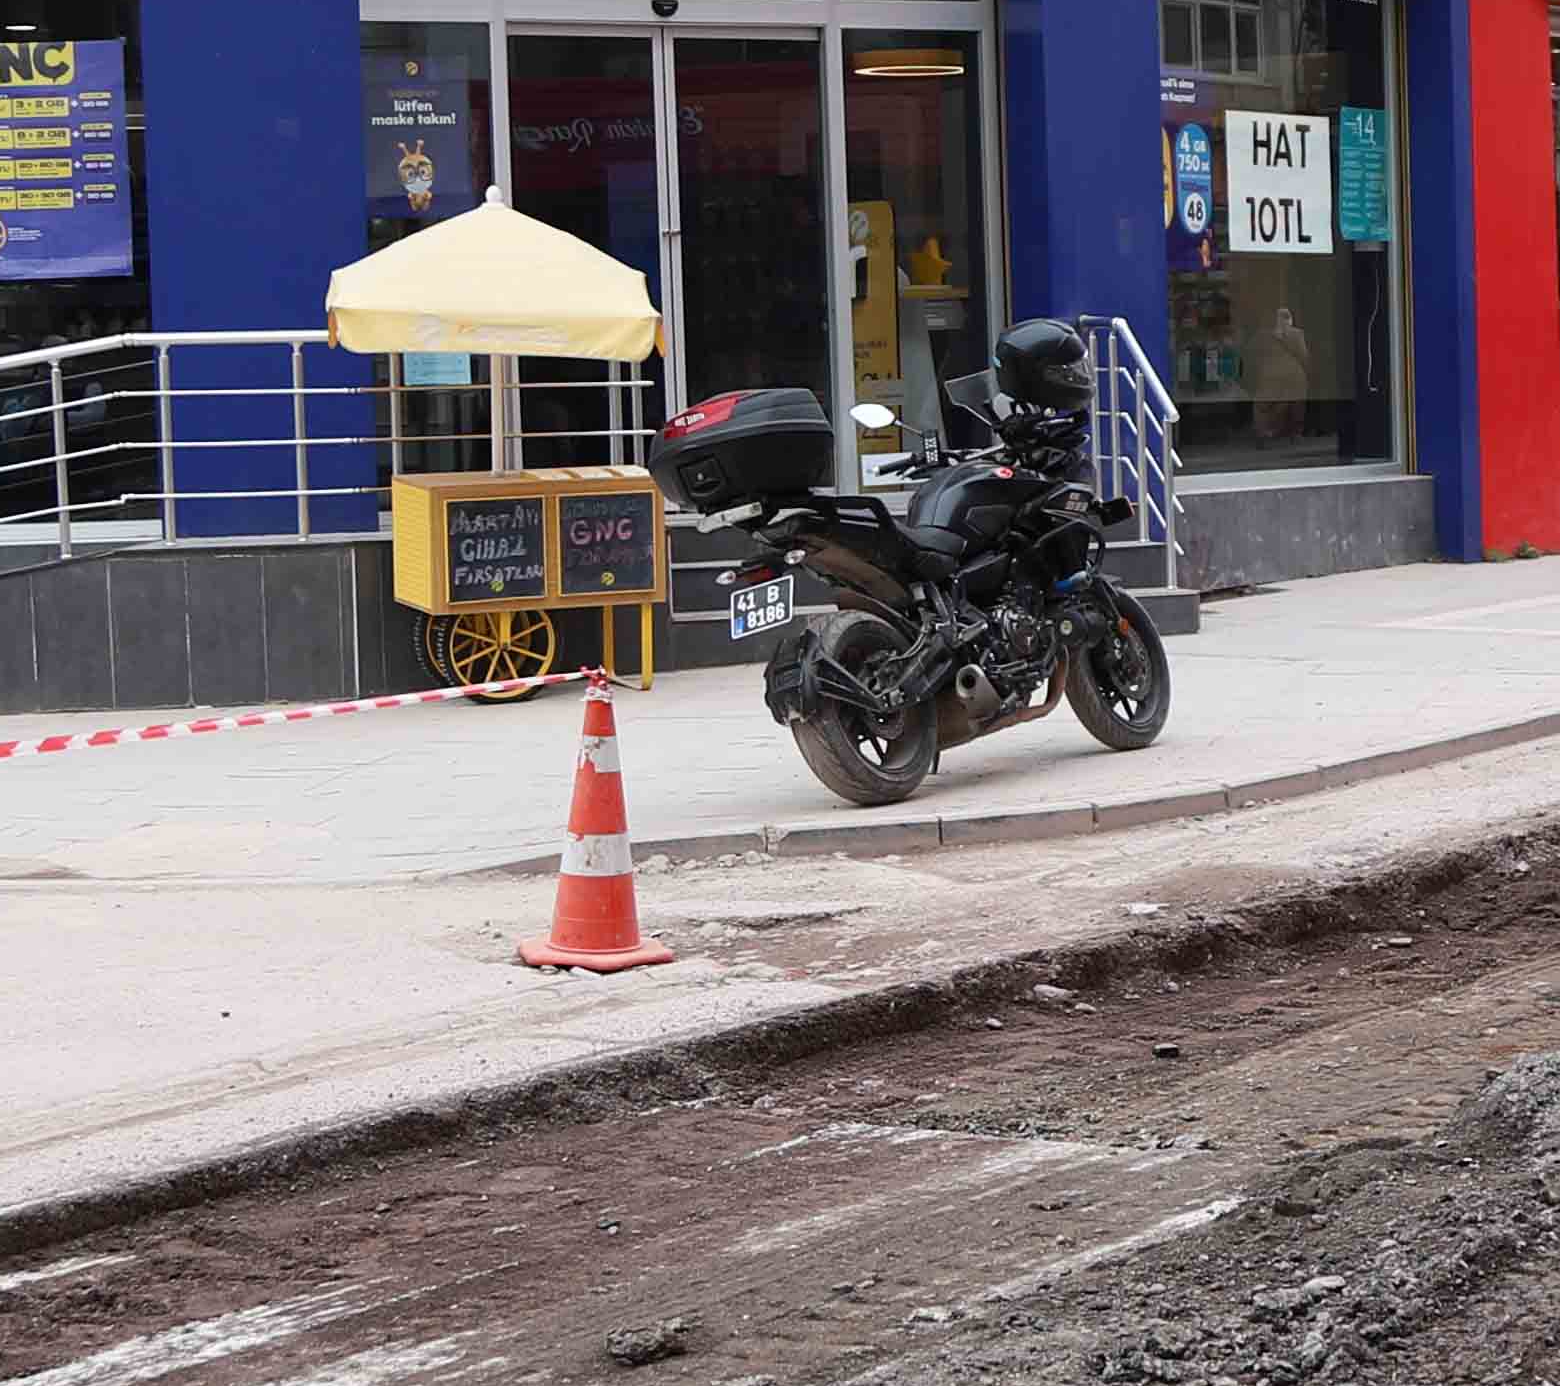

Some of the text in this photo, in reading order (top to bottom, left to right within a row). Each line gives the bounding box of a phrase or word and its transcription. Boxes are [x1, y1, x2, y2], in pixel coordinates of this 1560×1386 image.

[393, 100, 433, 112] lütfen
[371, 112, 457, 126] maske takın!
[1180, 131, 1189, 150] 4
[1252, 121, 1311, 169] HAT
[1178, 154, 1200, 172] 750
[1187, 201, 1204, 221] 48
[1245, 197, 1312, 244] 10TL
[737, 585, 780, 612] 41 B
[747, 601, 786, 629] 8186
